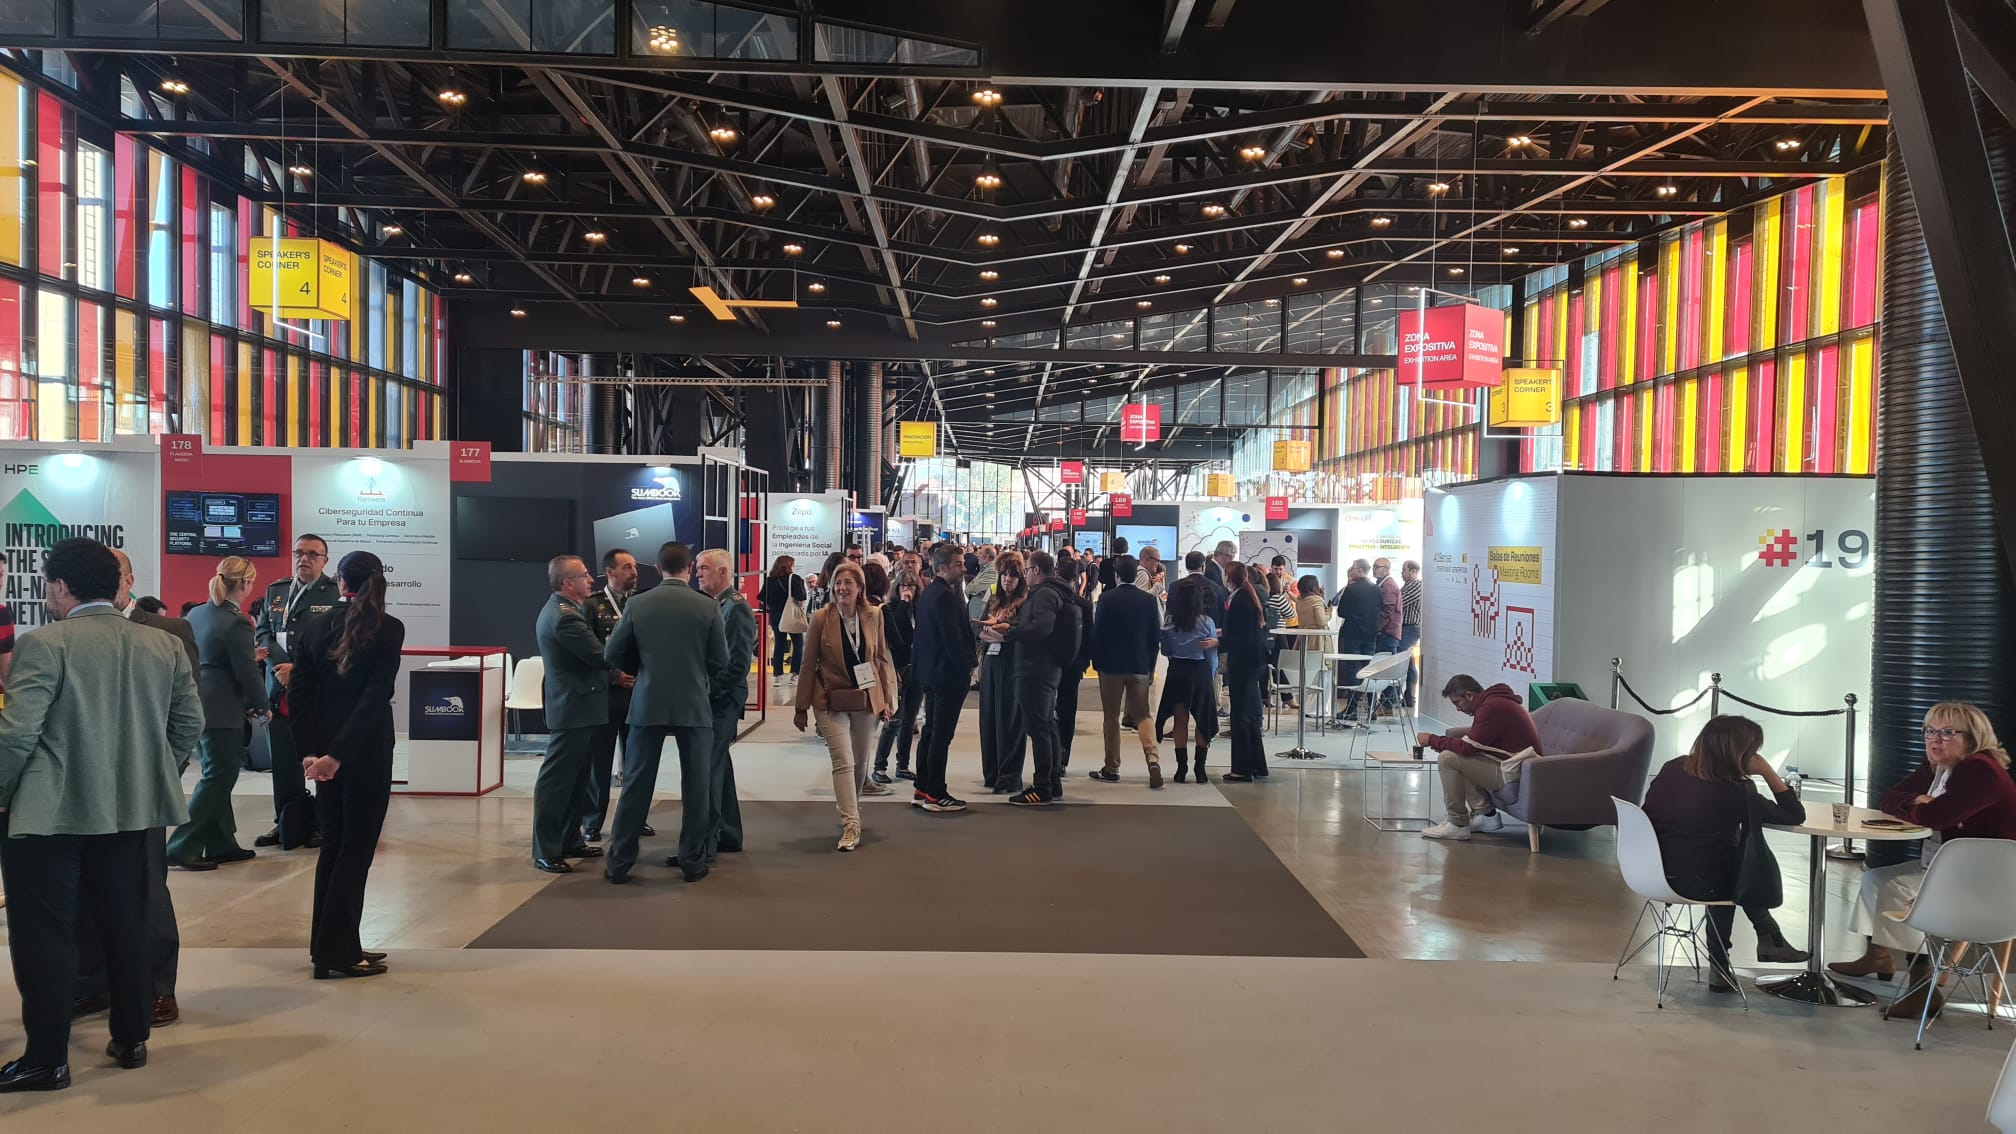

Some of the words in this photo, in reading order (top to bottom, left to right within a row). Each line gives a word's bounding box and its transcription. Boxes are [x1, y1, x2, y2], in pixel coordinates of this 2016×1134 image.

[257, 250, 310, 260] SPEAKER'S
[257, 260, 300, 269] CONER
[323, 254, 348, 270] SPEAKER'S
[323, 264, 342, 278] CORNER
[300, 282, 311, 295] 4
[342, 292, 347, 304] 4
[1469, 328, 1484, 339] ZONA
[1468, 340, 1498, 353] EXPOSITIVA
[1546, 402, 1553, 412] 3
[171, 440, 192, 450] 178
[460, 448, 480, 456] 177
[4, 464, 39, 474] HPE
[318, 508, 384, 516] Ciberseguridad
[368, 519, 406, 527] Empresa
[6, 550, 38, 574] THE
[1489, 551, 1503, 561] Salas
[1504, 552, 1510, 561] de
[1511, 551, 1540, 563] Reuniones
